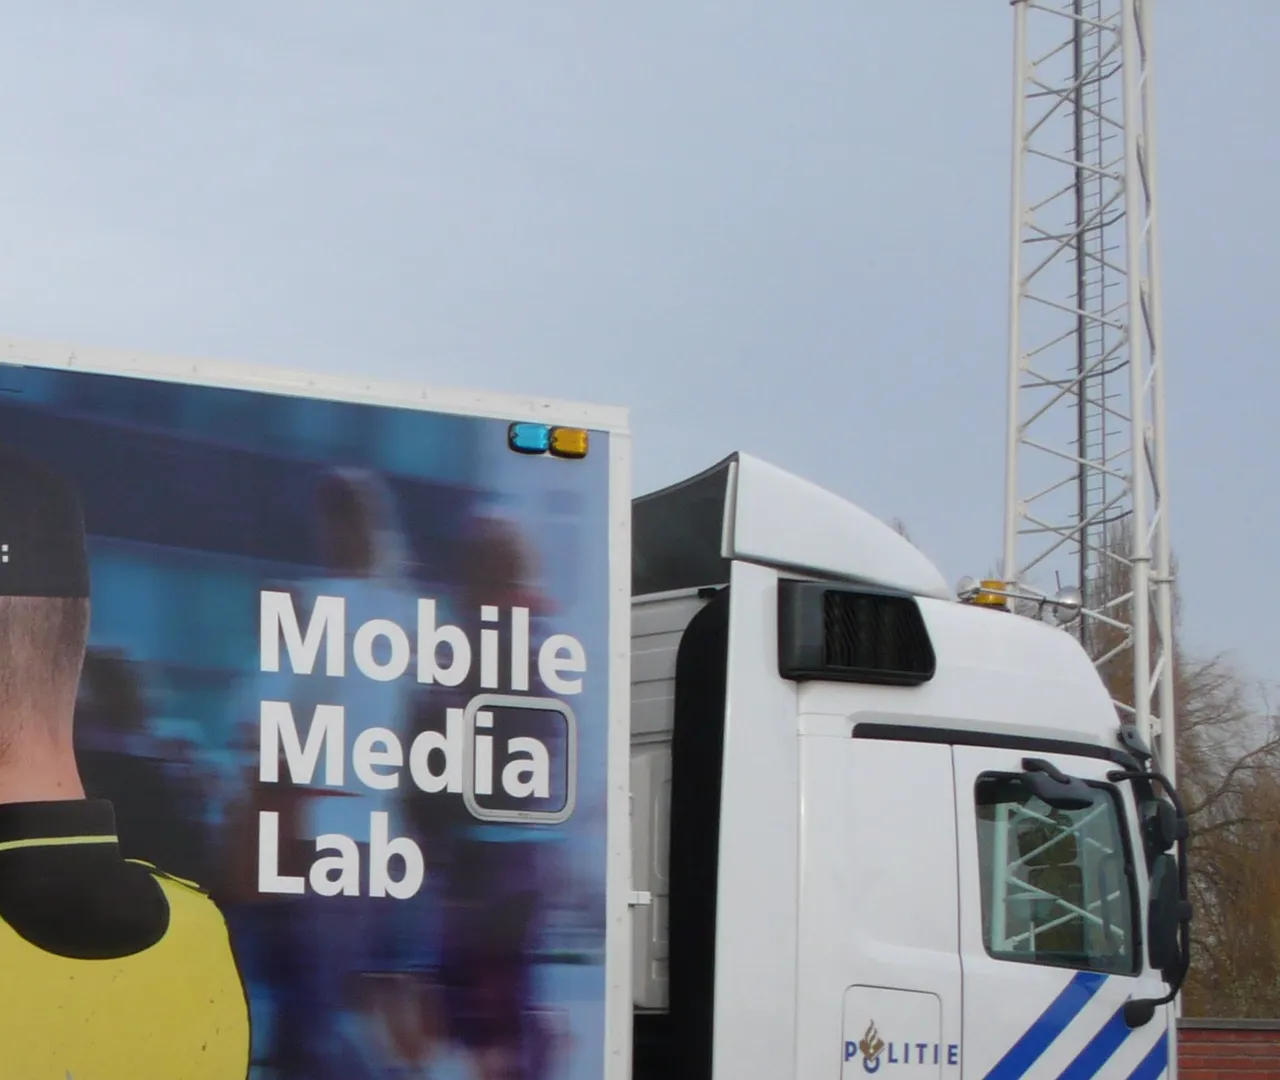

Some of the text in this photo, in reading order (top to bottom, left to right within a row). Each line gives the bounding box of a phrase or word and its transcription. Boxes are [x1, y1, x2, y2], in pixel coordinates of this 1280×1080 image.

[260, 590, 587, 695] Mobile
[260, 700, 550, 798] Media
[258, 811, 425, 900] Lab
[844, 1040, 958, 1073] POLITIE
